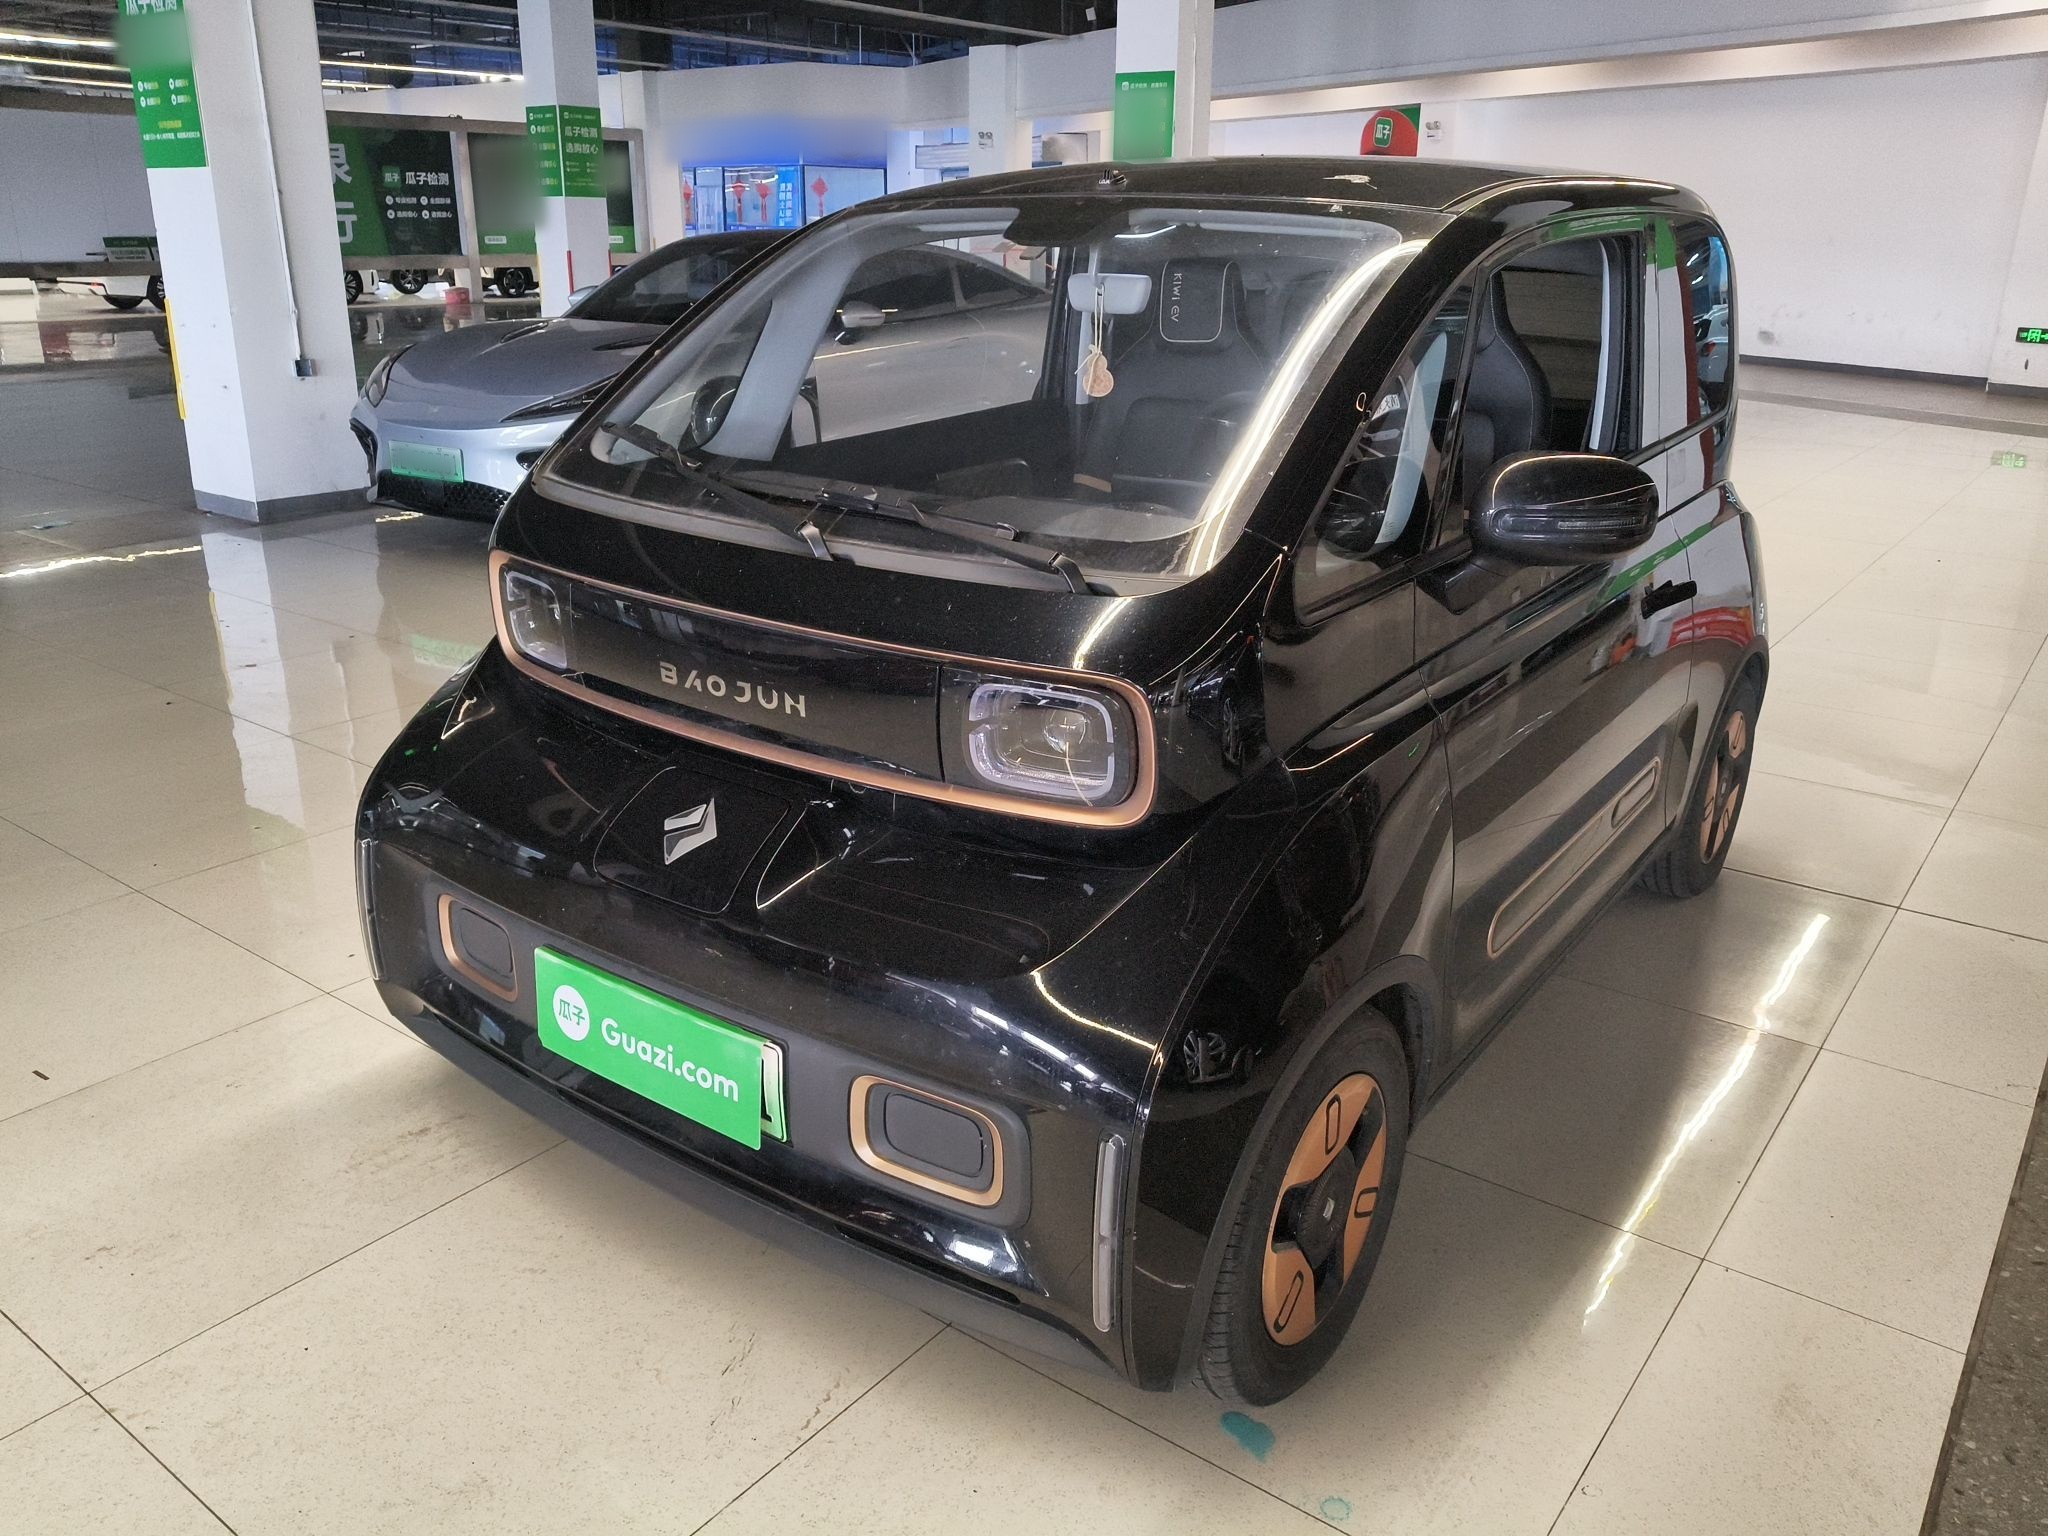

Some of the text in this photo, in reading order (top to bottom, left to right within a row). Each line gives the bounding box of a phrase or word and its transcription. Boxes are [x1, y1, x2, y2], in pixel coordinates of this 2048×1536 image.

[565, 126, 598, 138] 瓜子检测
[1375, 124, 1390, 139] 瓜子
[385, 172, 400, 182] 瓜子
[405, 171, 450, 186] 瓜子检测
[1171, 272, 1182, 300] KIWI
[659, 661, 806, 718] BAOJUN
[558, 998, 586, 1026] 瓜子
[601, 1017, 739, 1104] Guazi.com
